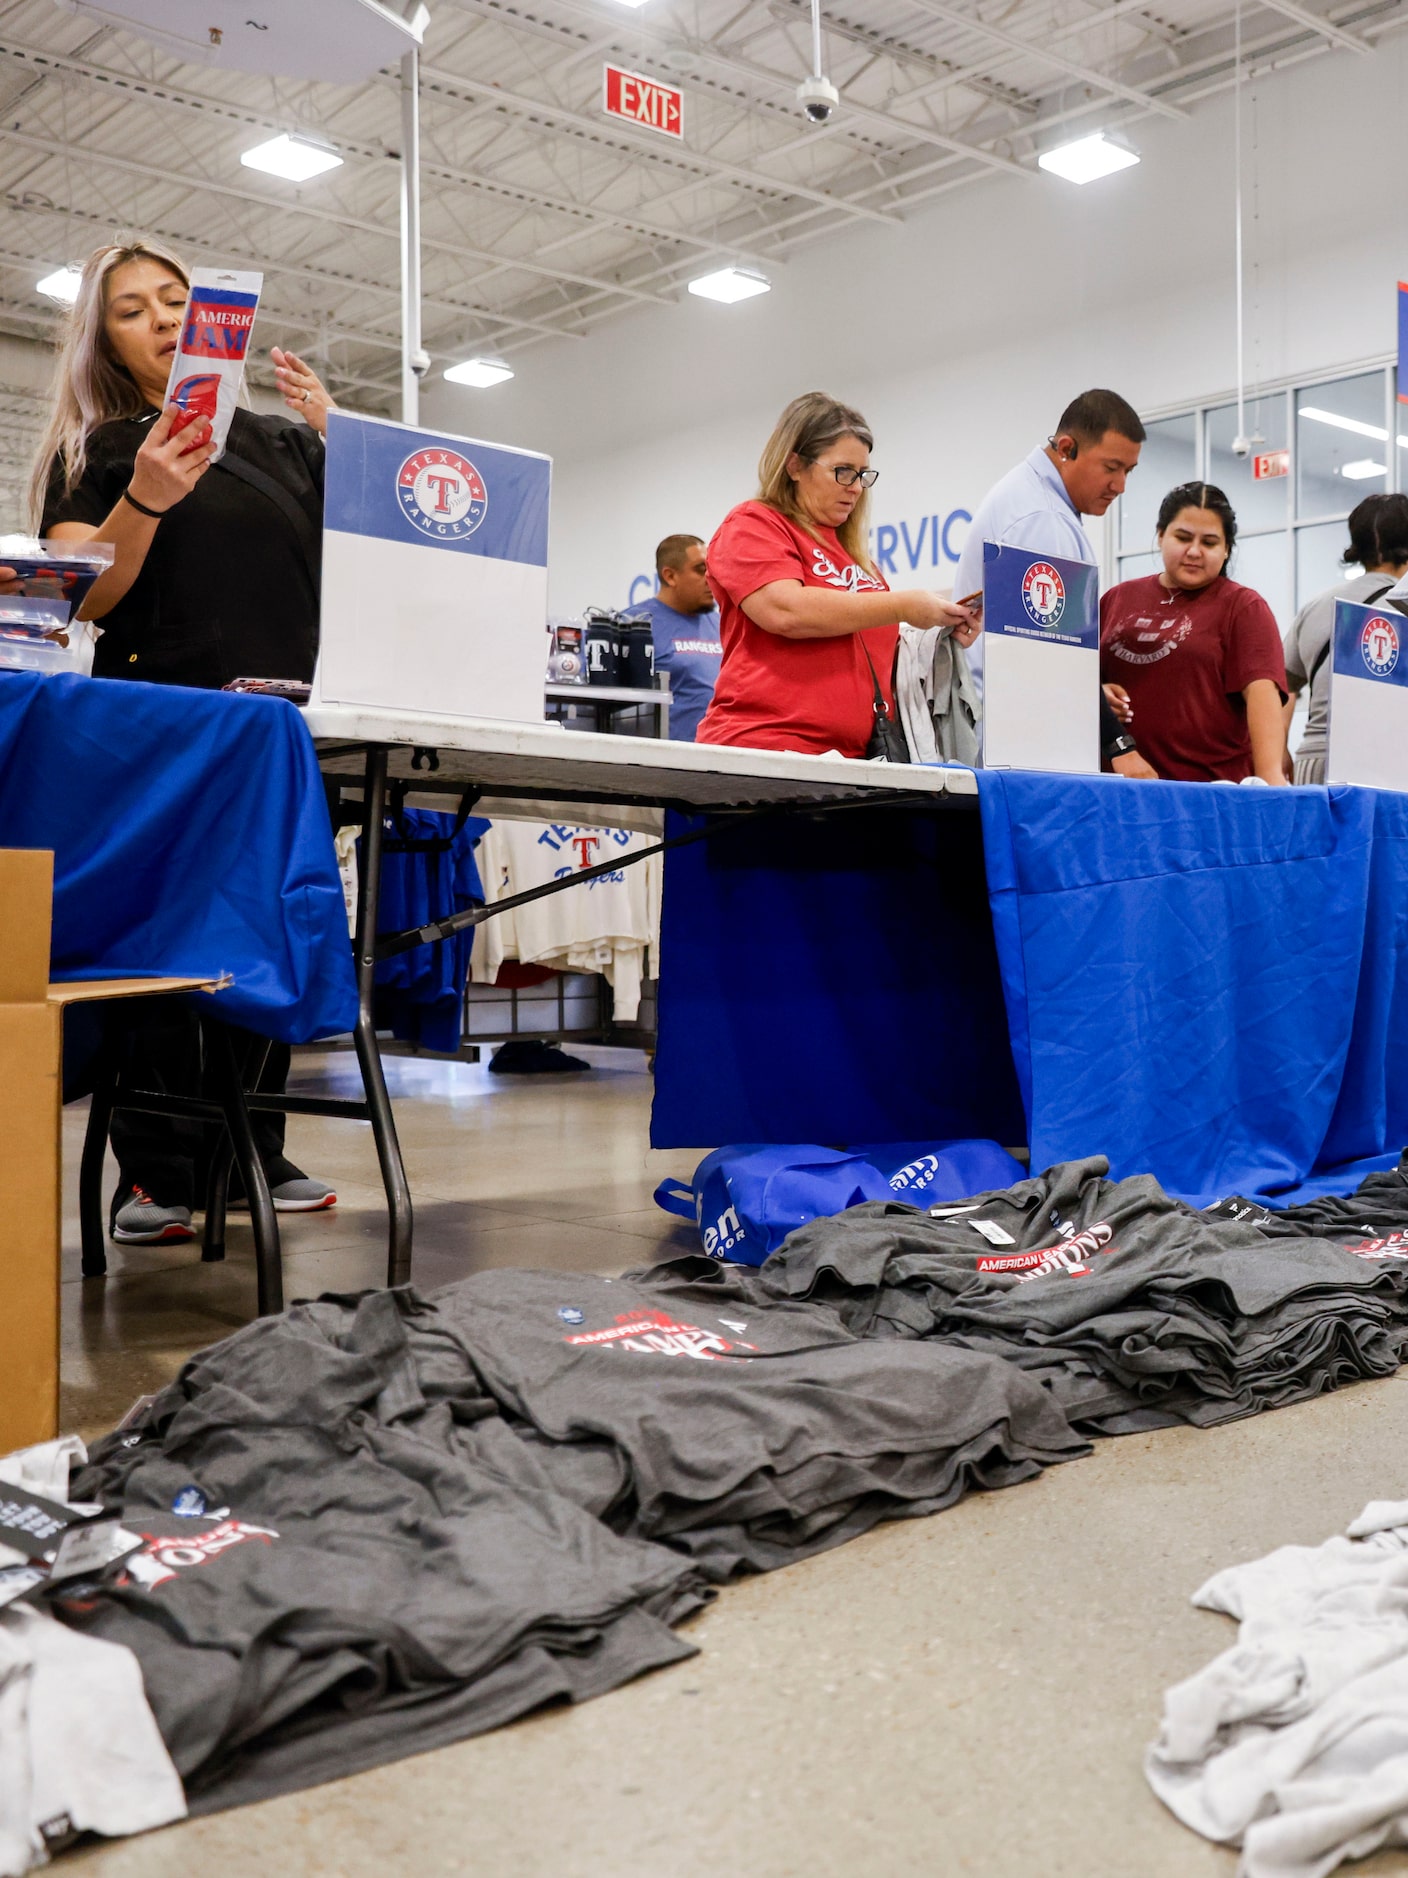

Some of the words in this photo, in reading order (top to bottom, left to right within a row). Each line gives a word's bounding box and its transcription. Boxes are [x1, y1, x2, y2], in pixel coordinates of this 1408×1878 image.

[620, 75, 673, 129] EXIT
[411, 453, 475, 480] TEXAS
[427, 474, 460, 515] T
[403, 494, 481, 535] RANGERS
[1028, 565, 1060, 584] TEXAS
[1024, 595, 1063, 624] RANGERS
[674, 640, 724, 654] RANGERS
[572, 837, 601, 869] T
[978, 1255, 1038, 1272] AMERICAN
